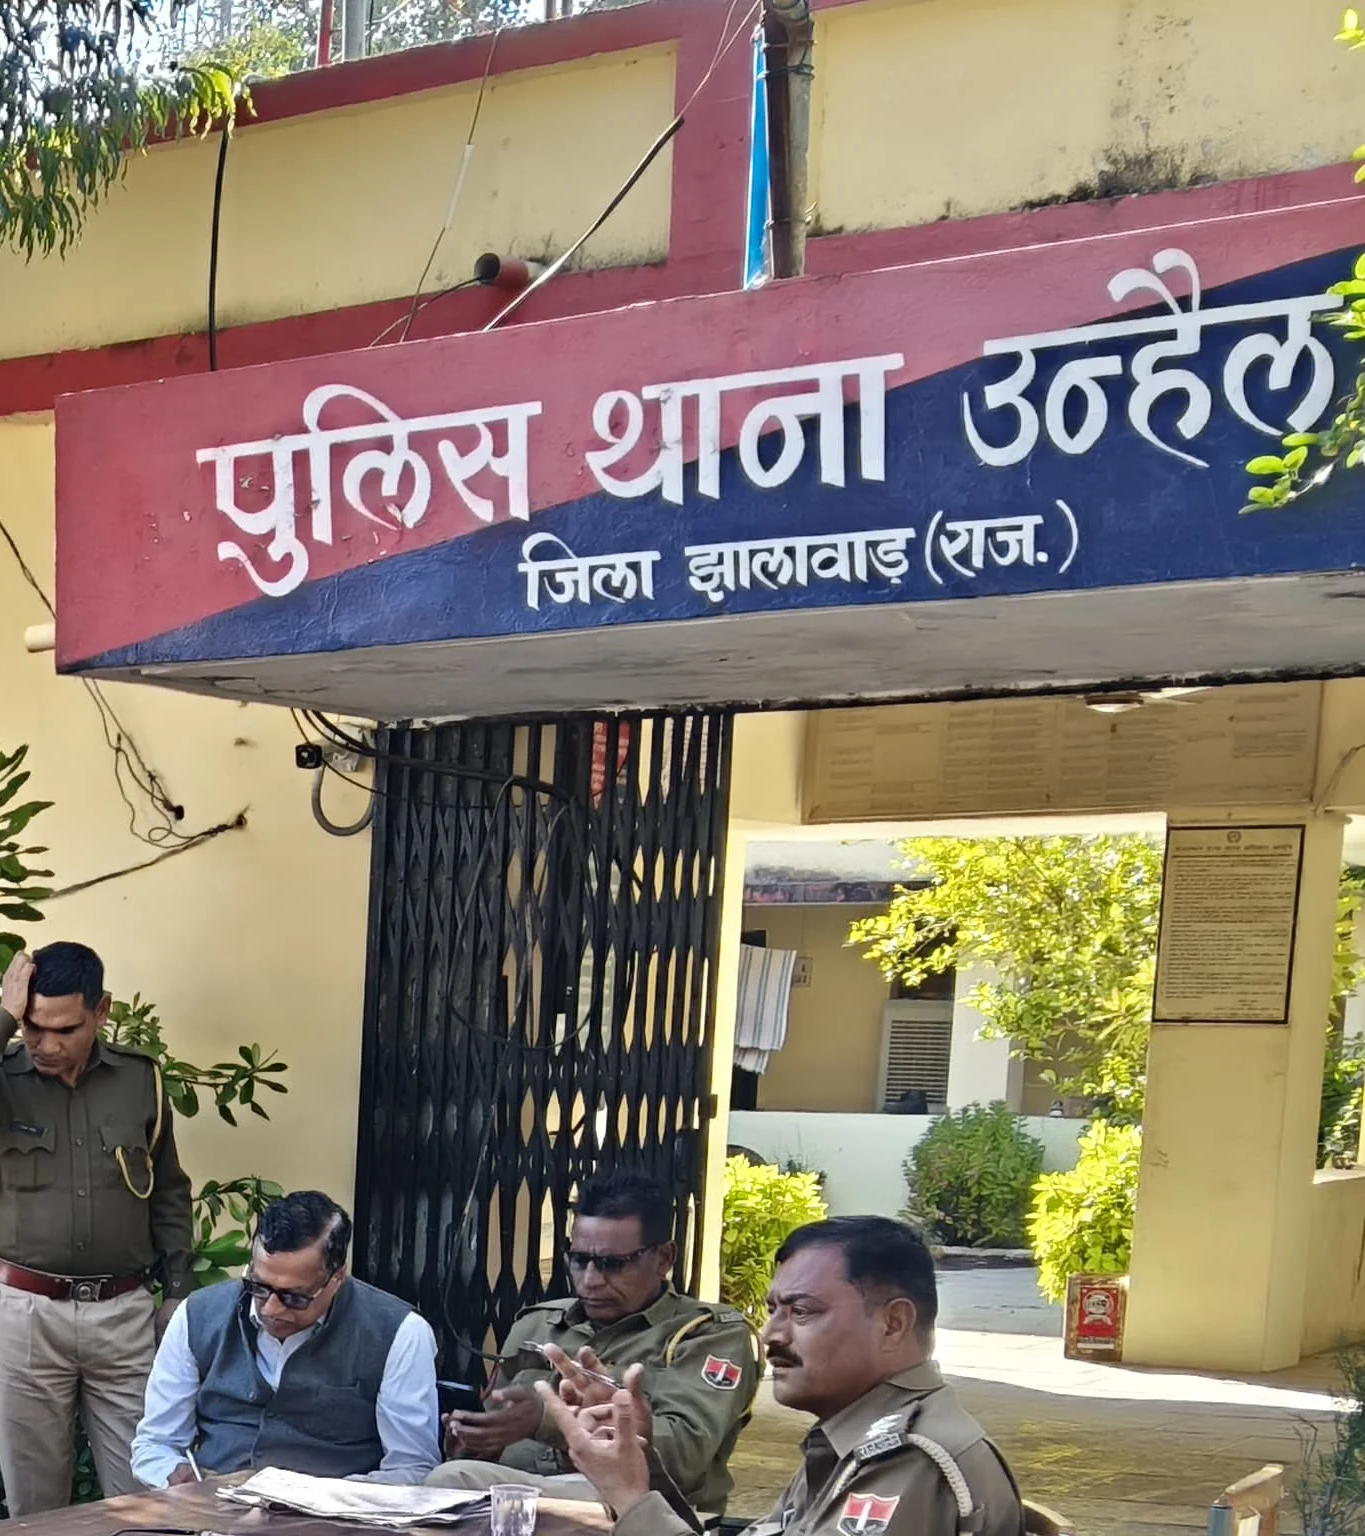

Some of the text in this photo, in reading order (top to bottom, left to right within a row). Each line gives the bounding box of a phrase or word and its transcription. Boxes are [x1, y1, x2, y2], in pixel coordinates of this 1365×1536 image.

[195, 247, 1345, 598] पुलिस थाना उन्हैल
[518, 499, 1080, 611] जिला झालावाड़ (राज.)
